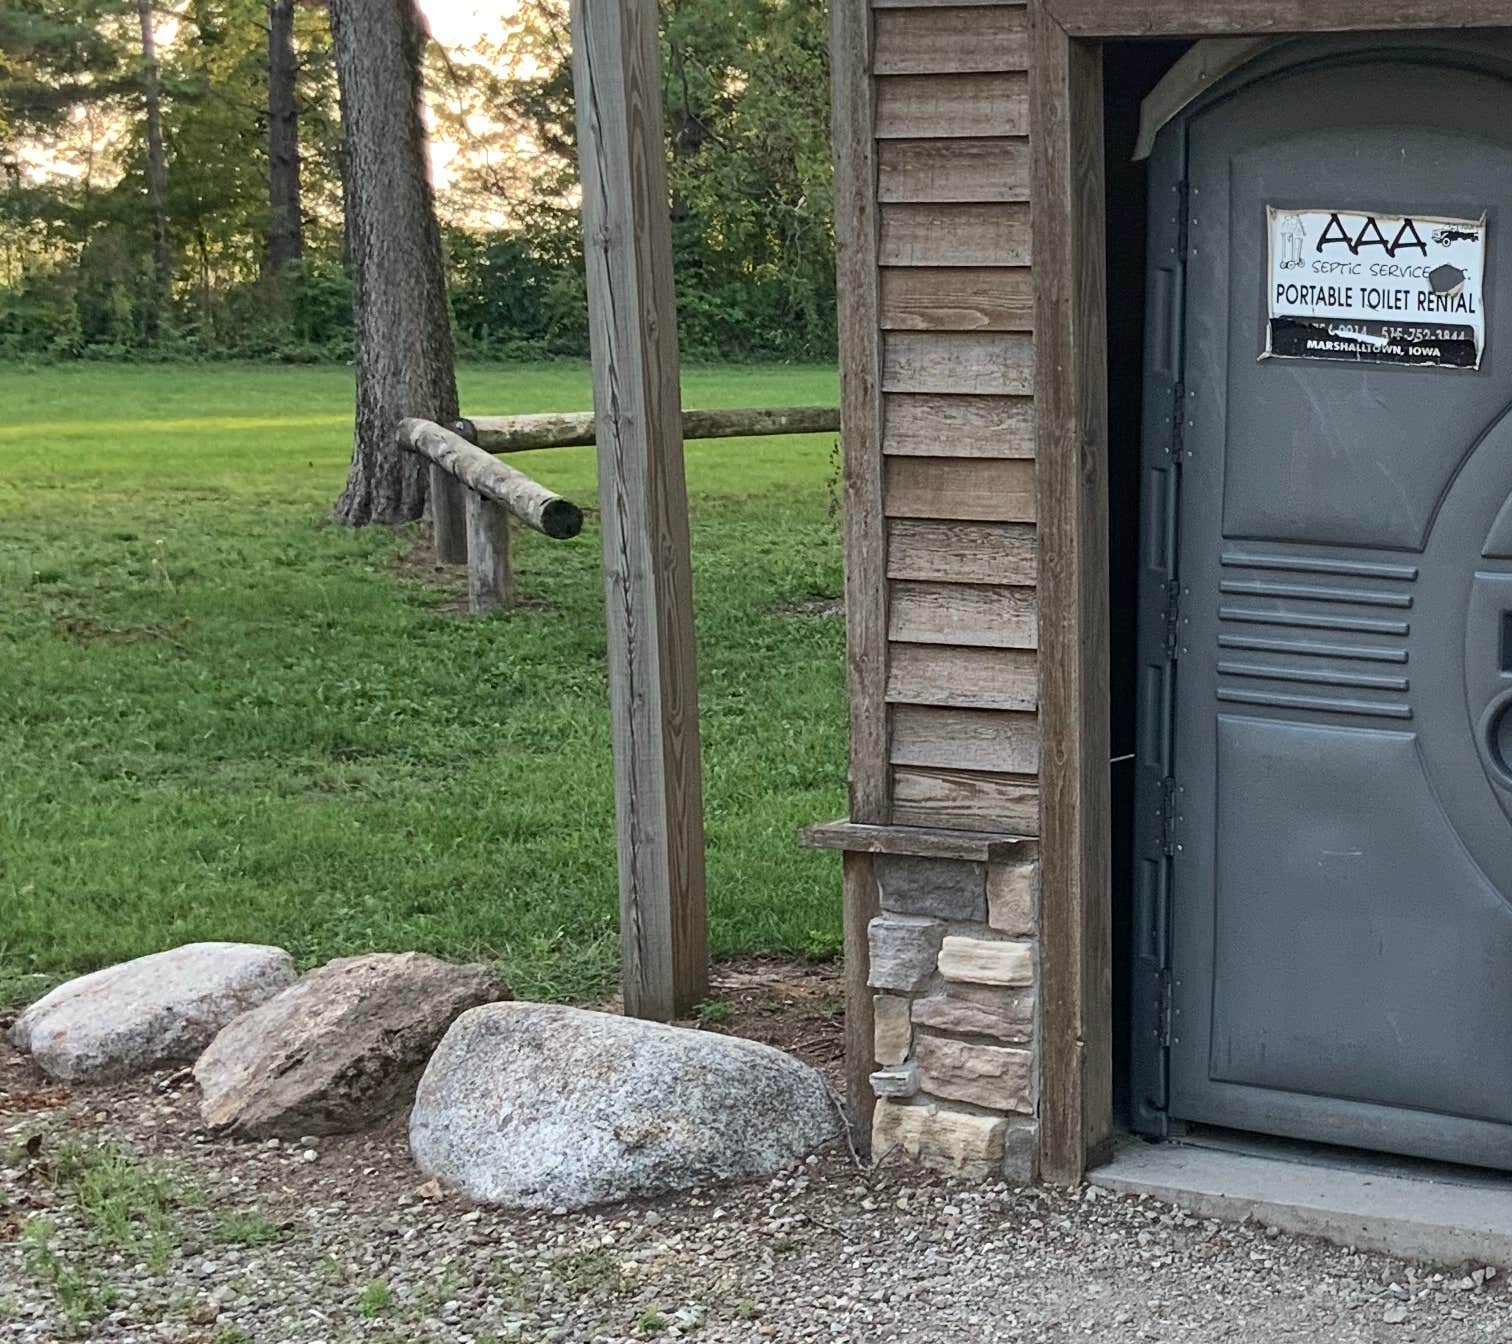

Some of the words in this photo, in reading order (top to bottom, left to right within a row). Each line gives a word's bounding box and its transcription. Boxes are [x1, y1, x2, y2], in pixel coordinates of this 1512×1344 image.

[1316, 213, 1427, 257] AAA
[1276, 284, 1352, 307] PORTABLE
[1360, 288, 1411, 312] TOILET
[1417, 290, 1476, 314] RENTAL
[1306, 340, 1405, 355] MARSHALLTOWN,
[1408, 347, 1441, 357] IOWA
